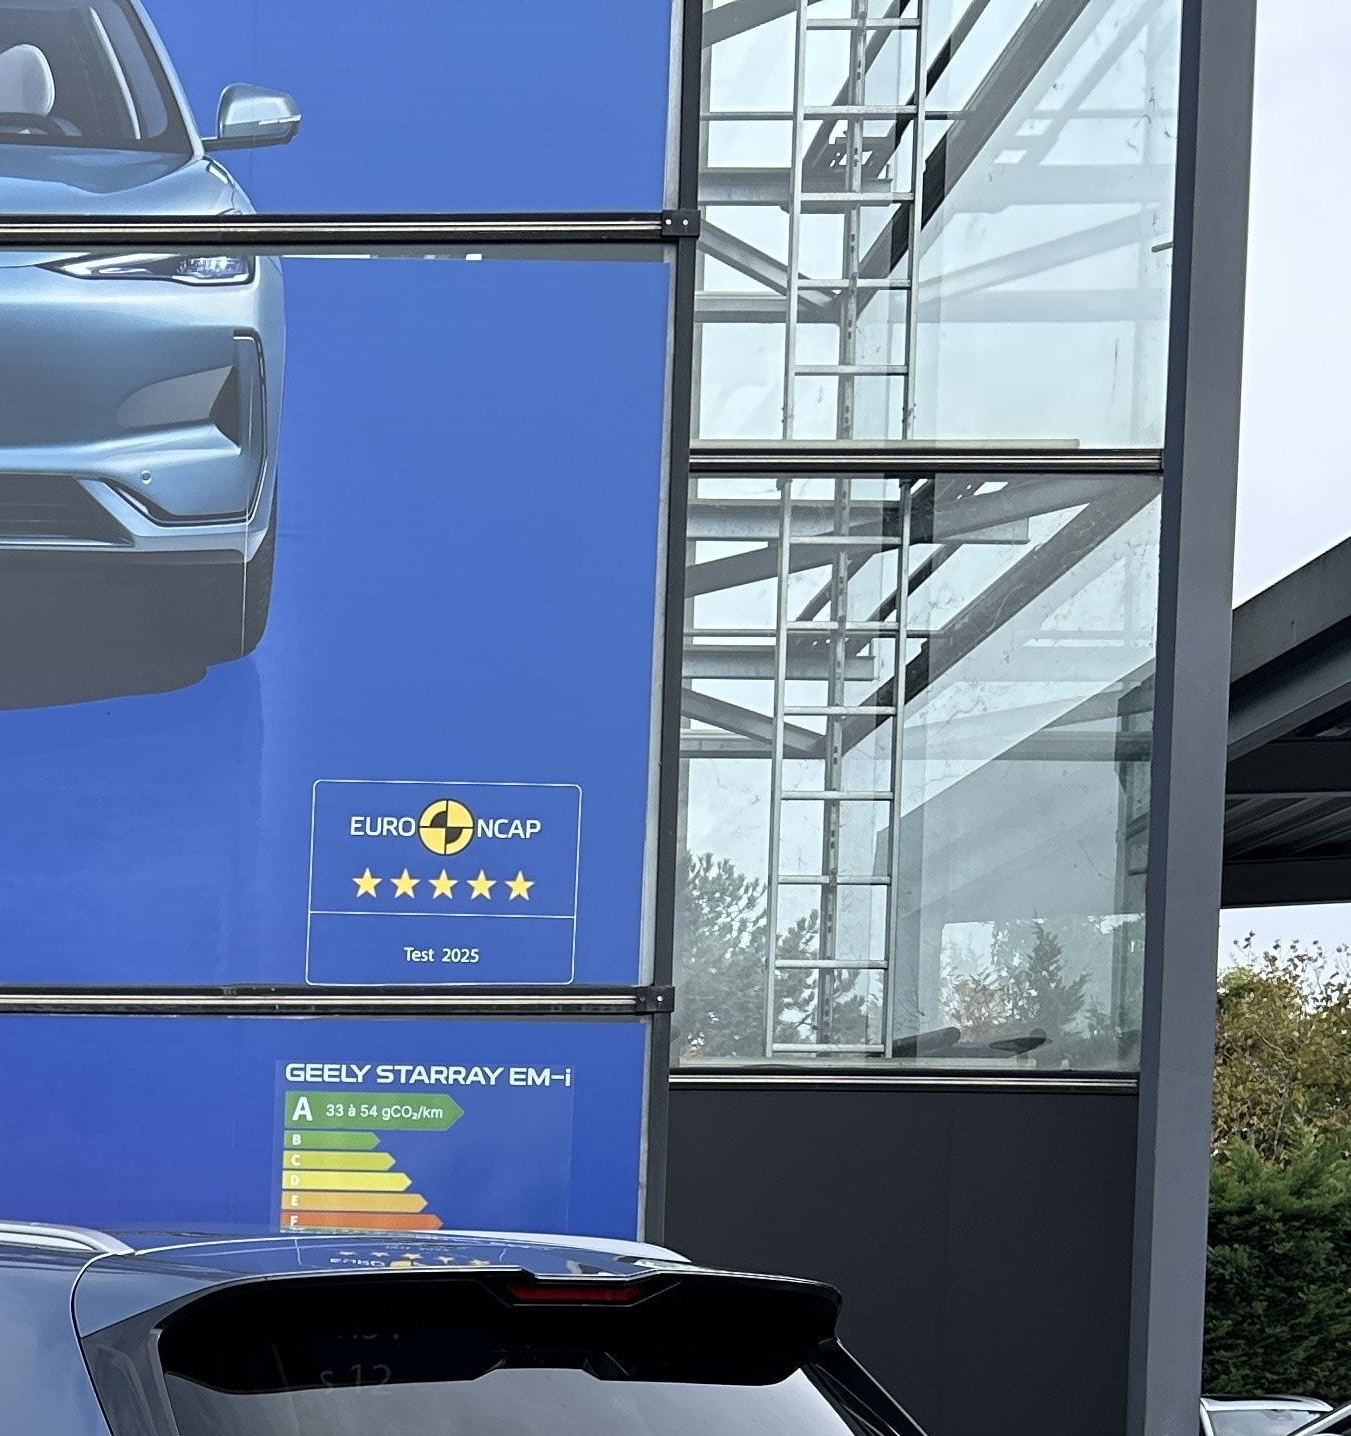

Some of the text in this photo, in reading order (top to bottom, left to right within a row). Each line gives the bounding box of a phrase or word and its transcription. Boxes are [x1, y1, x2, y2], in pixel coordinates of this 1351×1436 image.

[350, 815, 542, 840] EURO NCAP
[404, 947, 480, 964] Test 2025
[285, 1063, 572, 1087] GEELY STARRAY EM-i
[292, 1096, 313, 1121] A
[325, 1104, 345, 1118] 33
[347, 1103, 356, 1118] à
[360, 1105, 378, 1119] 54
[291, 1133, 302, 1145] B
[290, 1153, 301, 1166] C
[290, 1174, 301, 1187] D
[290, 1194, 300, 1207] E
